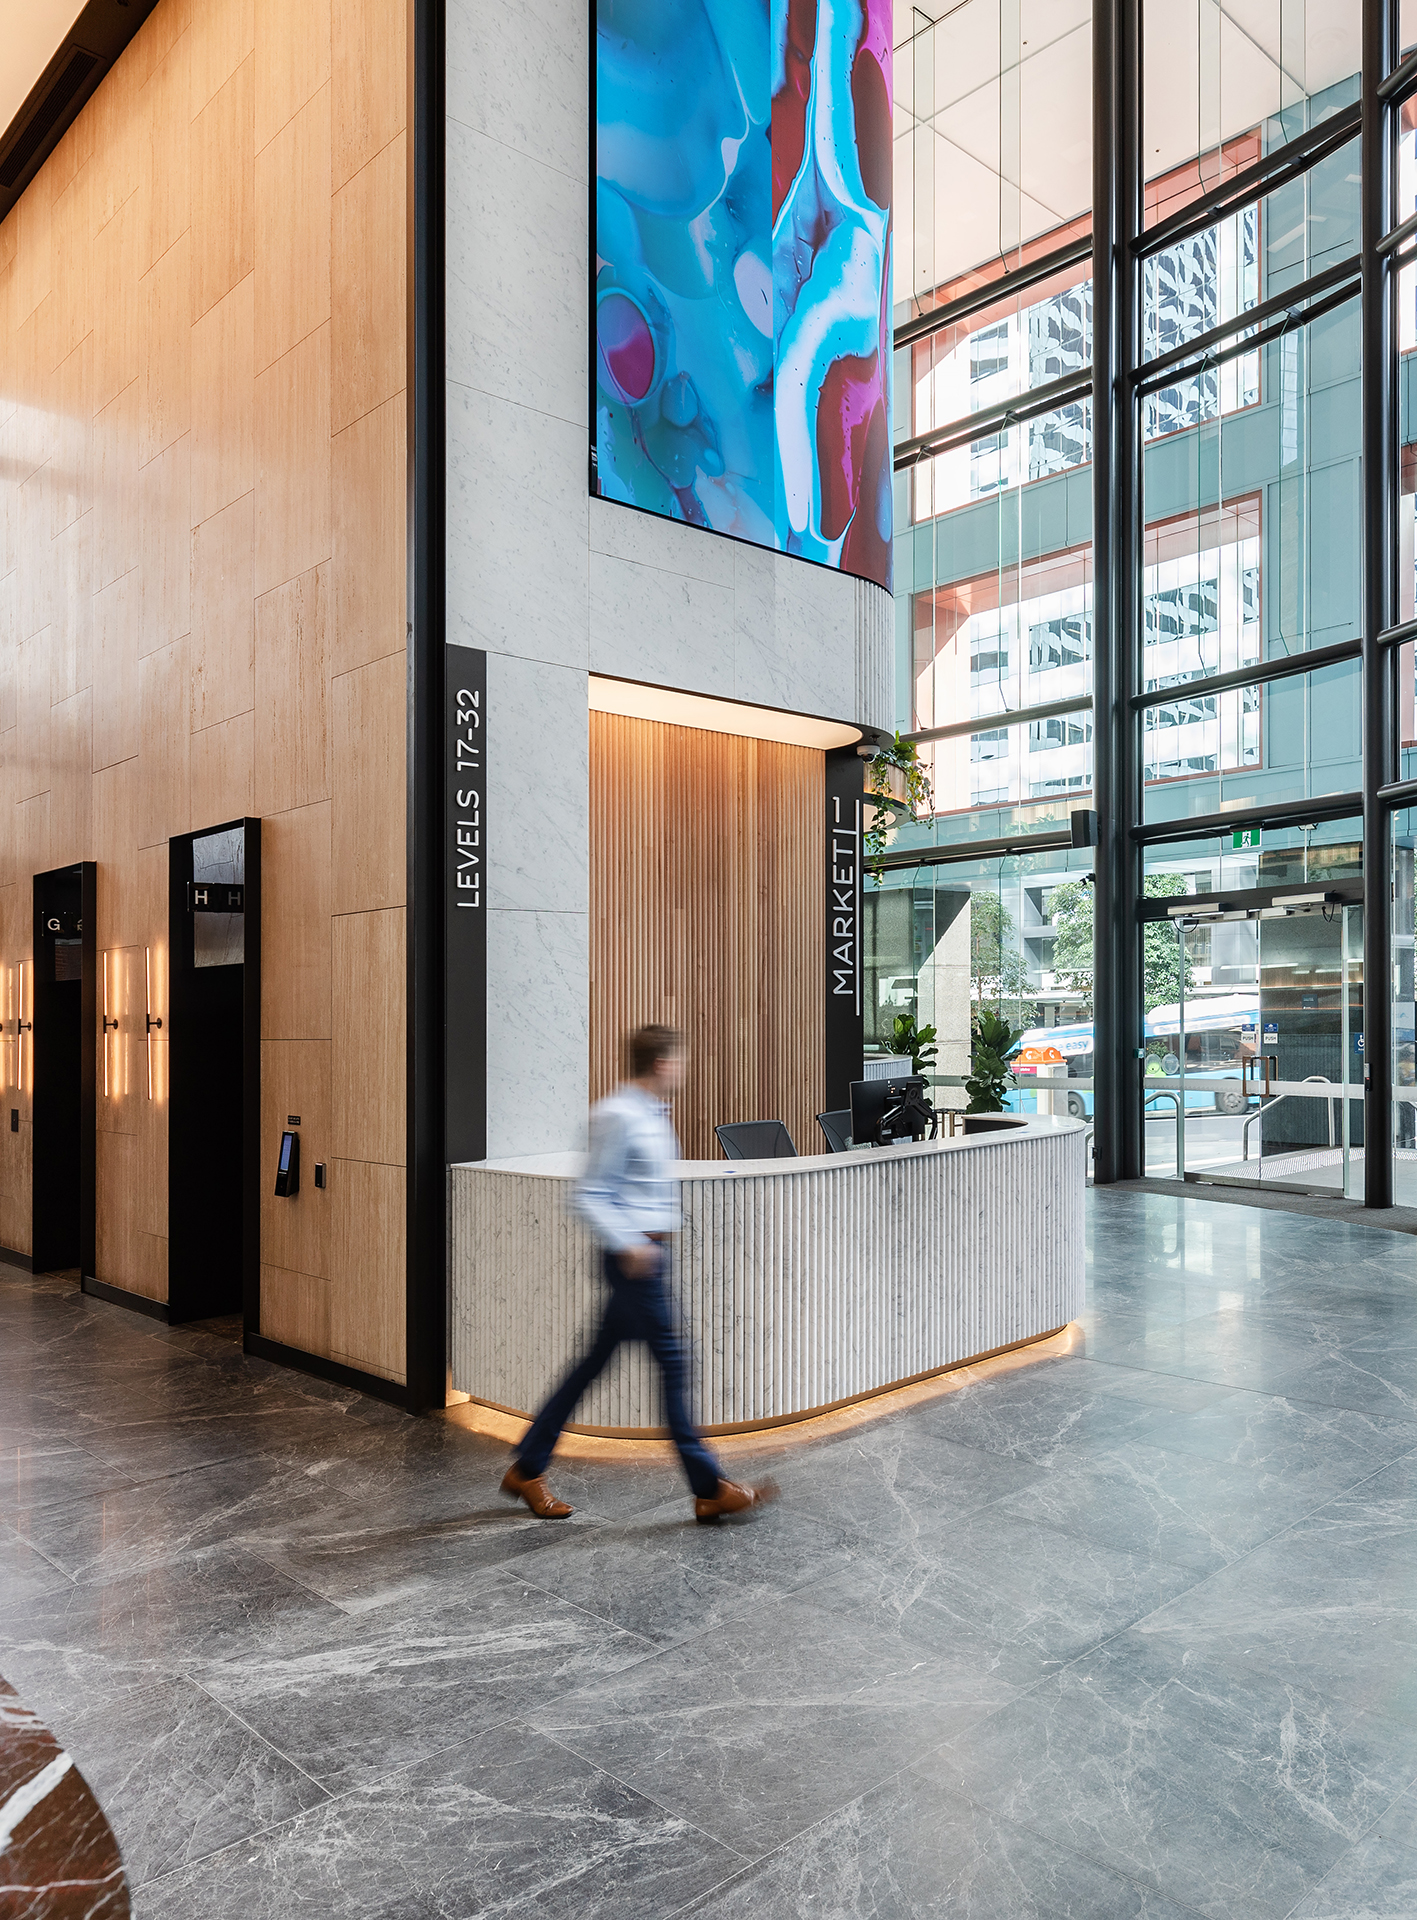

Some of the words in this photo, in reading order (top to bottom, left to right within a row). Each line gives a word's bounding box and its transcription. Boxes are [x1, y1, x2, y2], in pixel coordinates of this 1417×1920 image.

[456, 688, 480, 772] 17-32
[456, 789, 480, 908] LEVELS
[195, 889, 208, 905] H
[832, 838, 854, 995] MARKET
[47, 918, 61, 931] G
[1065, 1040, 1089, 1052] easy
